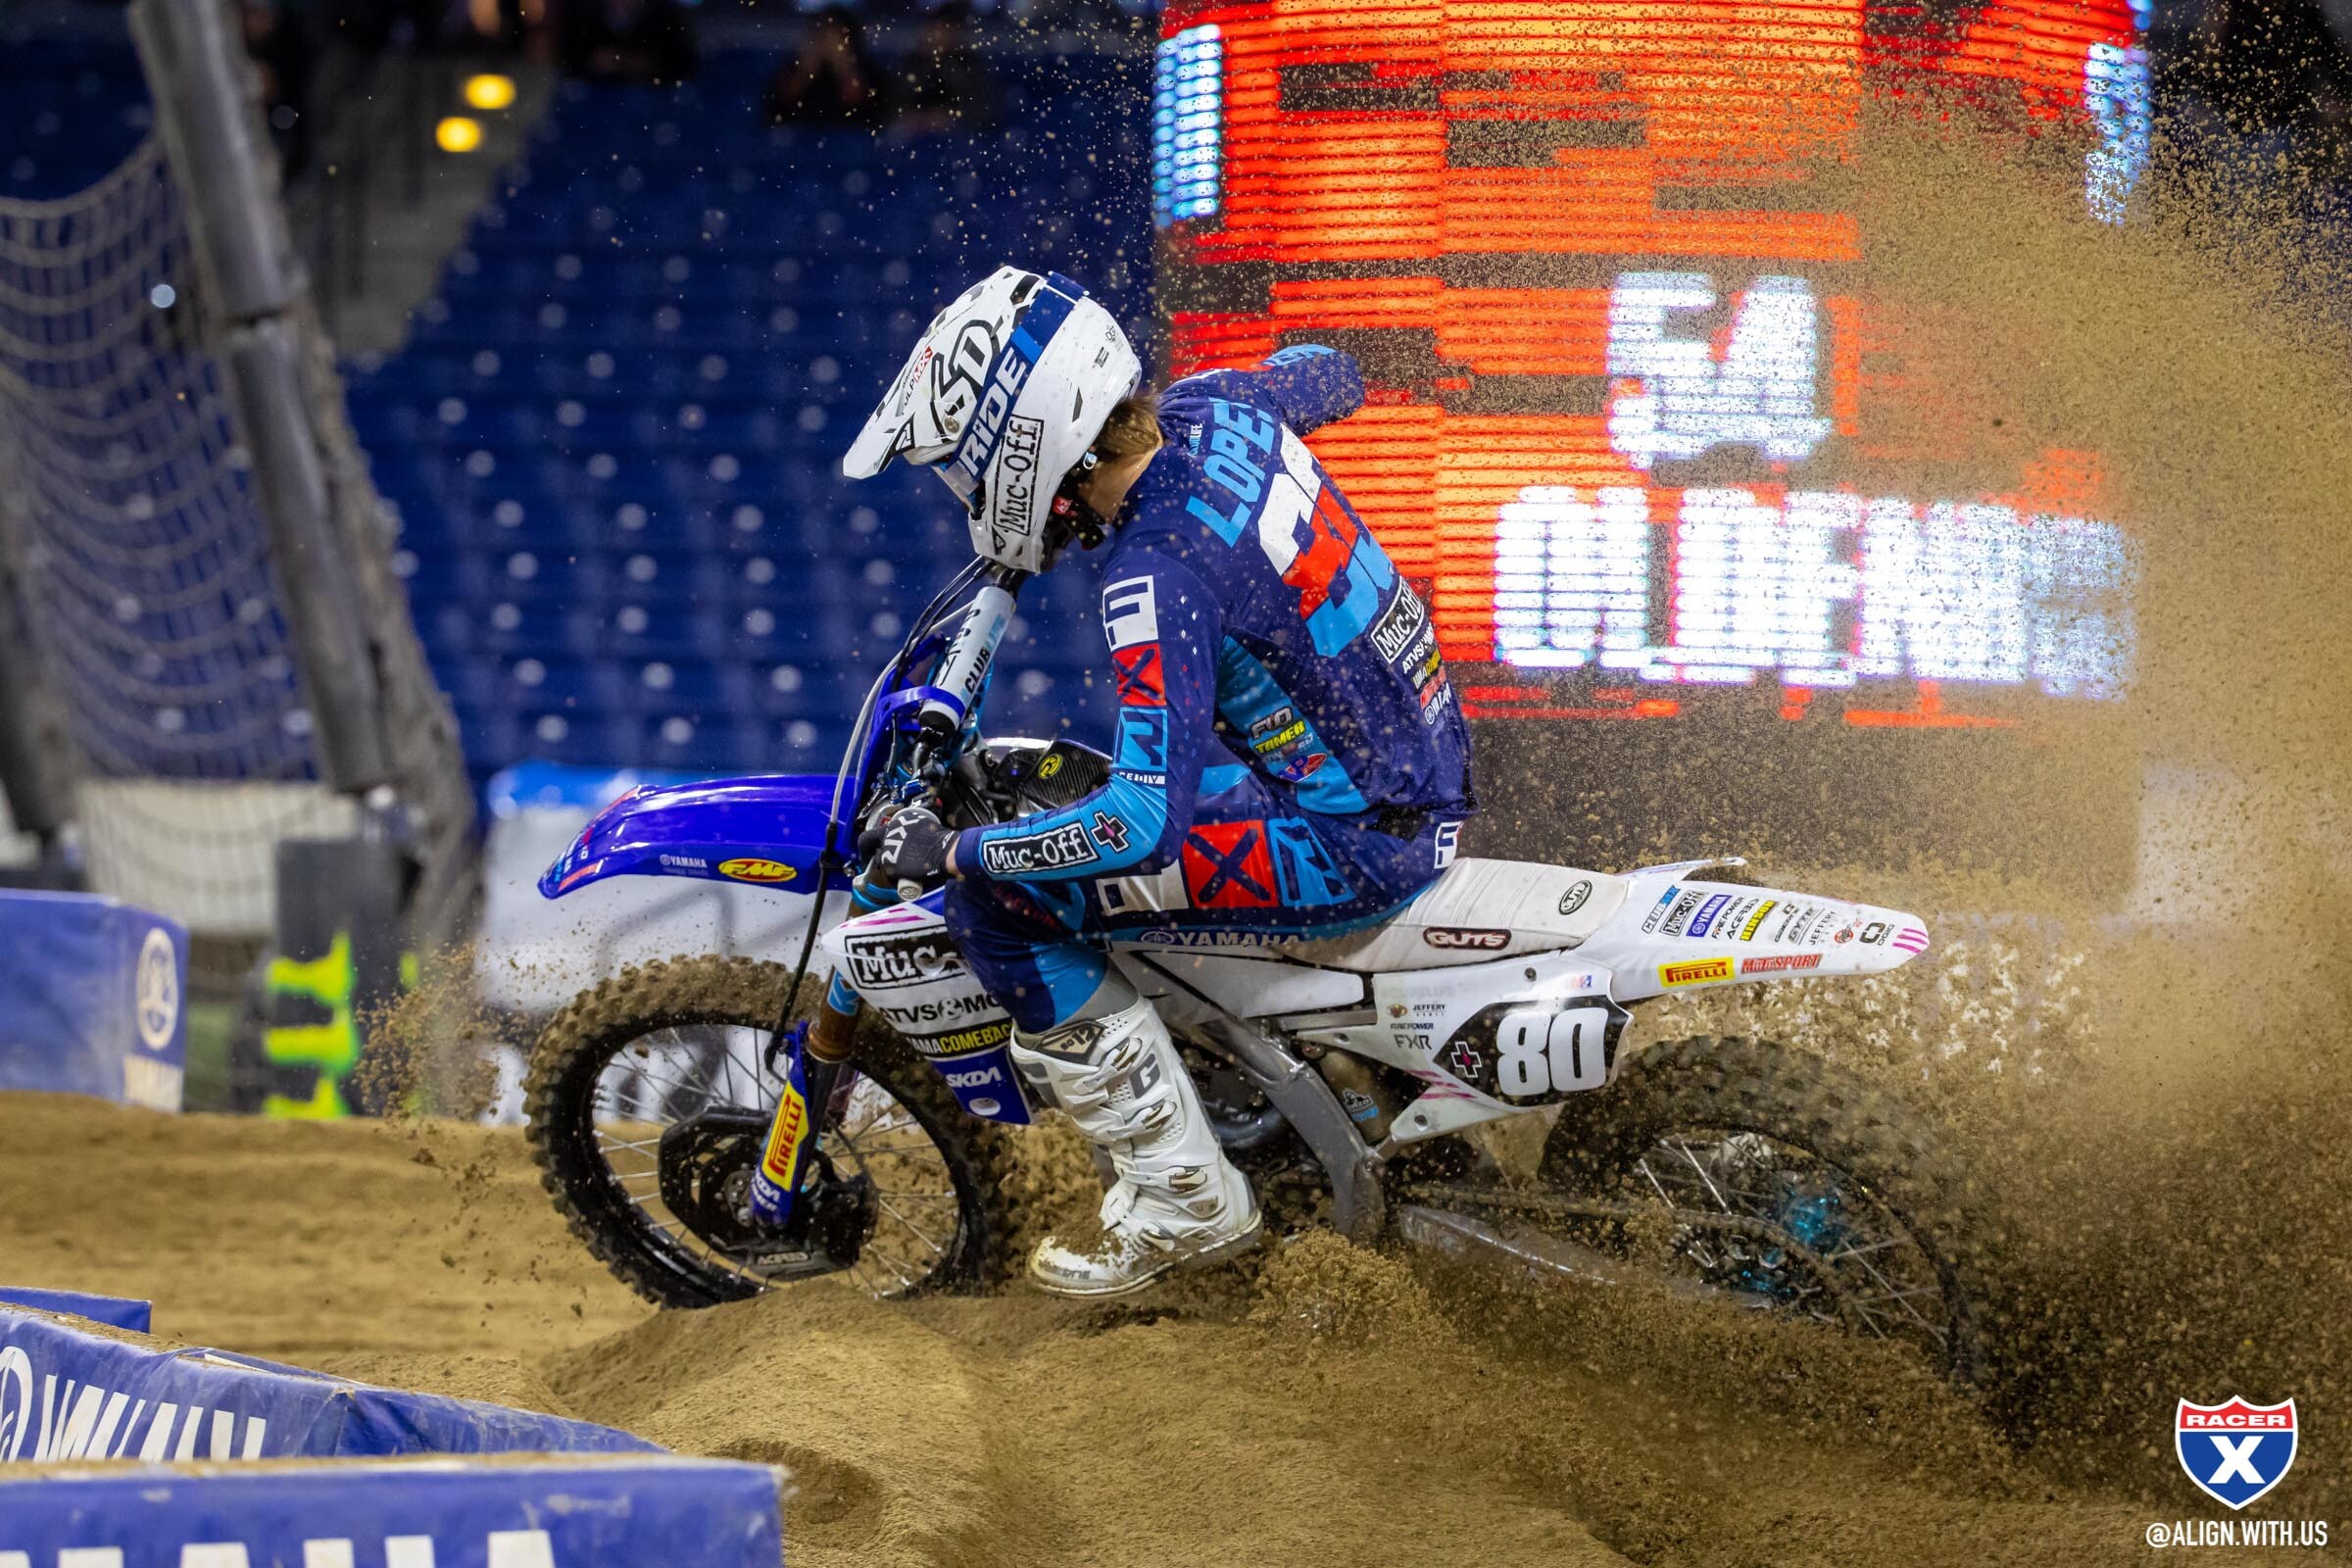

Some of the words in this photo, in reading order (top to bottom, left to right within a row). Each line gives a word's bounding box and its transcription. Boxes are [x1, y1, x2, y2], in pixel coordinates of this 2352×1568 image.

[959, 347, 1027, 477] RIDE
[1000, 418, 1038, 531] Muc-Off
[1186, 397, 1275, 549] LOPE
[669, 856, 708, 869] YAMAHA
[988, 826, 1088, 870] Muc-Off
[720, 862, 796, 877] FMF
[1178, 931, 1301, 948] YAMAHA
[1429, 932, 1506, 948] GUTS
[1808, 910, 1836, 946] JEFFERY
[1665, 961, 1727, 983] PIRELLI
[1394, 1035, 1432, 1050] FXR
[1496, 1007, 1609, 1097] 80
[946, 1065, 1002, 1088] SKDA
[768, 1093, 802, 1178] PIRELLI
